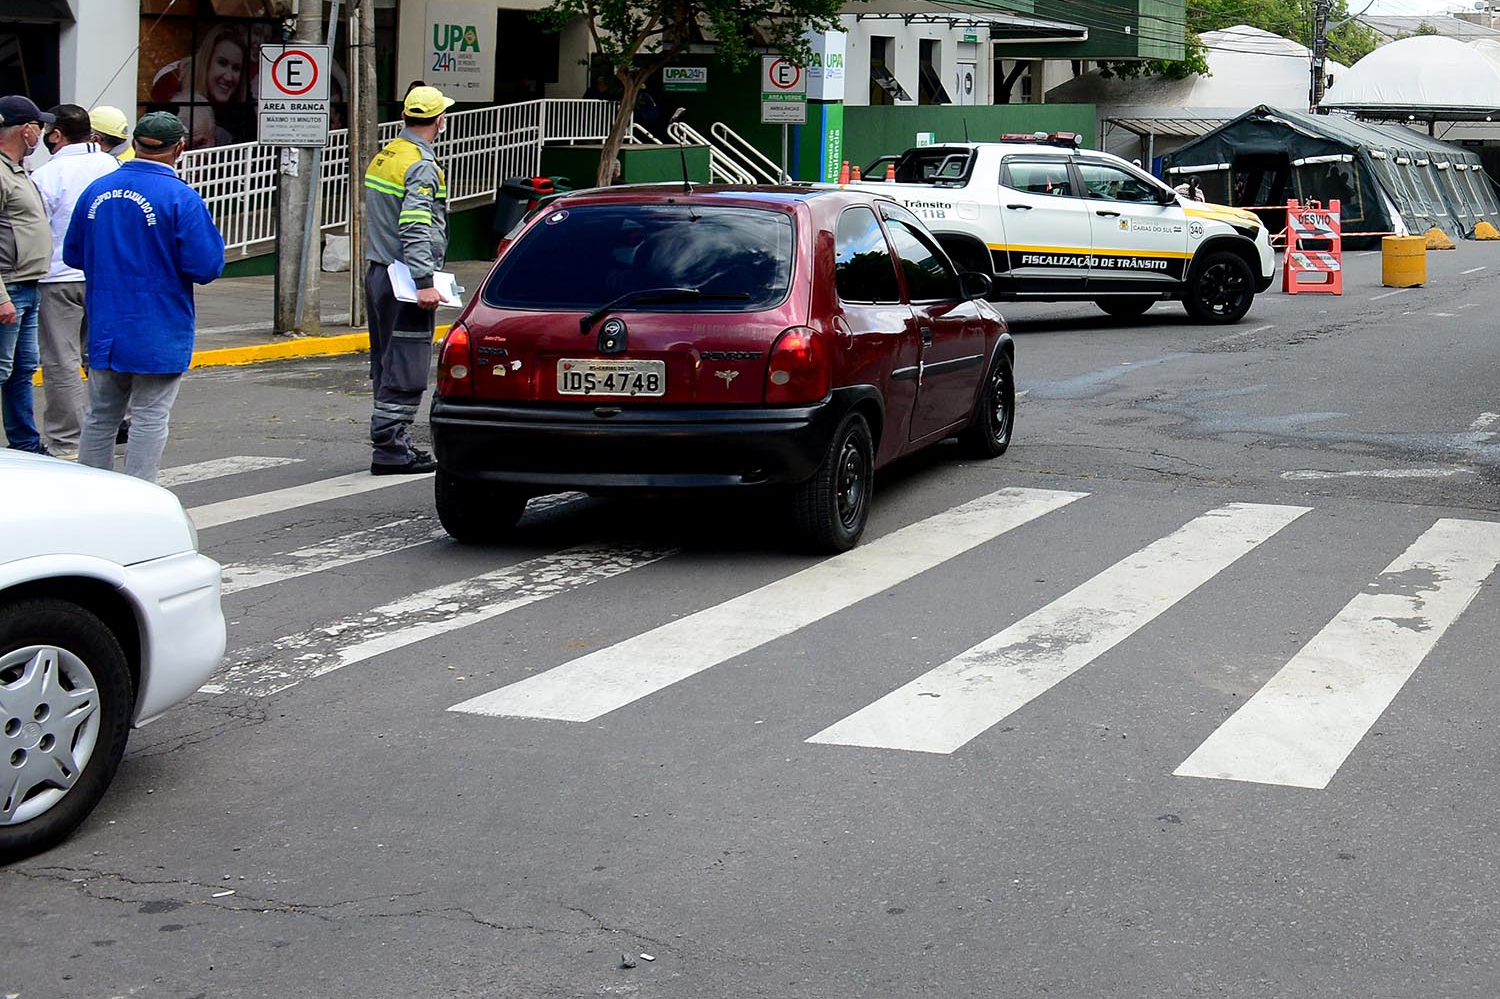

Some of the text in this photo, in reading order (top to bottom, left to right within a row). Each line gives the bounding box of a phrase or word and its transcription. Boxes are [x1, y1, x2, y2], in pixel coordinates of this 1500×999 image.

[433, 24, 480, 52] UPA
[432, 52, 456, 72] 24h
[827, 53, 843, 68] UPA
[287, 60, 303, 86] E
[779, 66, 790, 83] E
[264, 102, 325, 111] ÁREA BRANCA
[112, 189, 123, 198] DE
[123, 190, 147, 206] CAXIAS
[140, 202, 153, 214] DO
[904, 199, 952, 209] Trânsito
[145, 213, 157, 227] SUL
[922, 209, 946, 219] 118
[1299, 214, 1331, 225] DESVIO
[1190, 225, 1203, 235] 340
[1022, 255, 1168, 269] FISCALIZAÇÃO DE TRÂNSITO
[563, 372, 659, 392] IDS-4748
